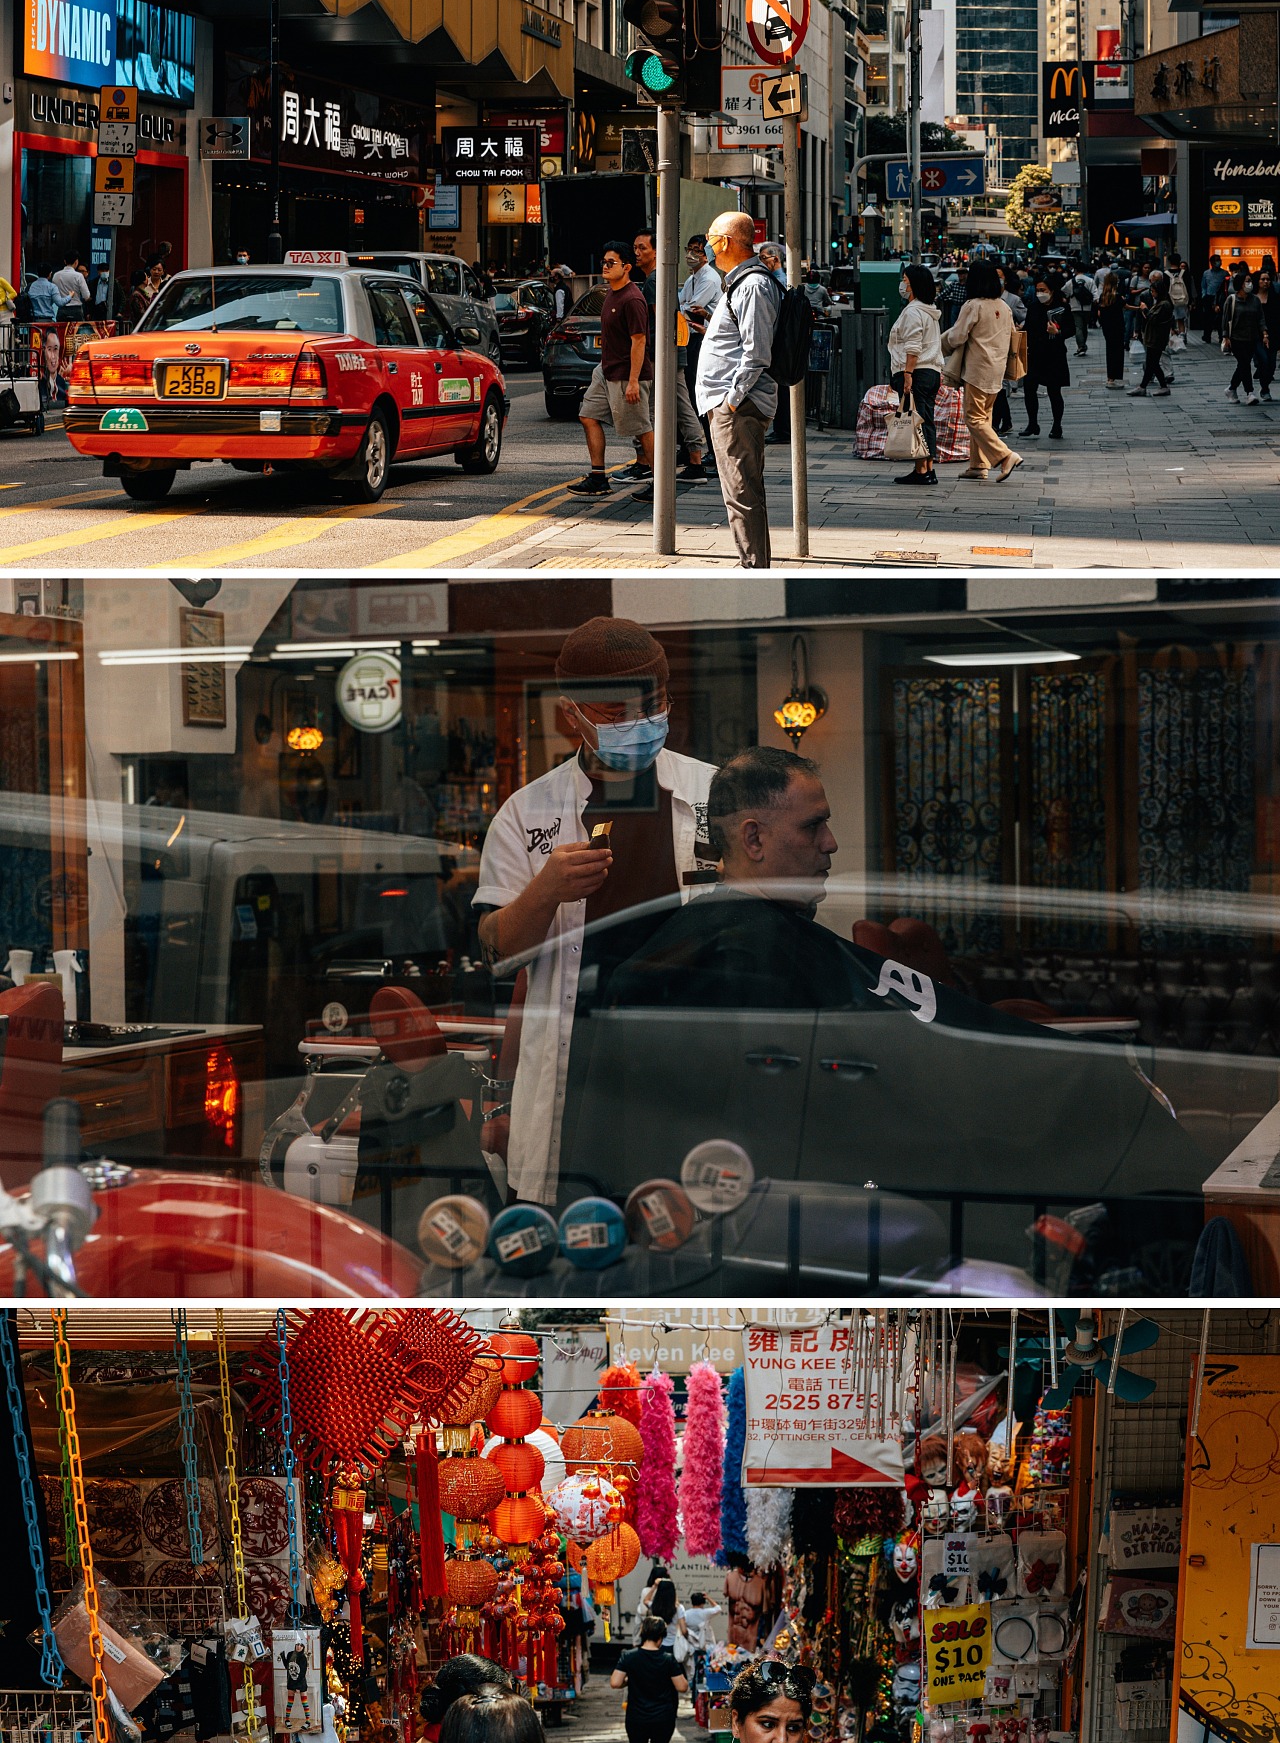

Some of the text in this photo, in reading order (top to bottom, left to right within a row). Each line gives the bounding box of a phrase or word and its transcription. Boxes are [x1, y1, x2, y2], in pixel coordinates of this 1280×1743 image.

[31, 93, 100, 130] UNDER
[1049, 108, 1080, 125] McCa
[281, 90, 340, 152] 周大福
[122, 125, 129, 136] 7
[351, 124, 401, 147] CHOW TAI FOOK
[736, 124, 783, 135] 3961 668
[100, 140, 135, 154] midnight 12
[456, 137, 524, 158] 周大福
[118, 195, 126, 207] 7
[1248, 203, 1273, 213] SUPER
[118, 212, 125, 224] 7
[289, 252, 341, 264] TAXI
[181, 366, 205, 381] KR
[168, 380, 216, 395] 2358
[412, 388, 424, 405] TAXI
[118, 413, 129, 423] 4
[613, 1344, 736, 1361] Seven Kee
[748, 1358, 796, 1370] YUNG
[801, 1358, 836, 1370] KEE
[788, 1377, 857, 1392] 電話 TE
[764, 1393, 821, 1410] 2525
[763, 1433, 826, 1441] POTTINGER
[1123, 1541, 1182, 1558] BIRTHDA
[675, 1563, 710, 1571] LANTIN
[935, 1644, 983, 1674] $10
[933, 1669, 986, 1687] ONE PACK
